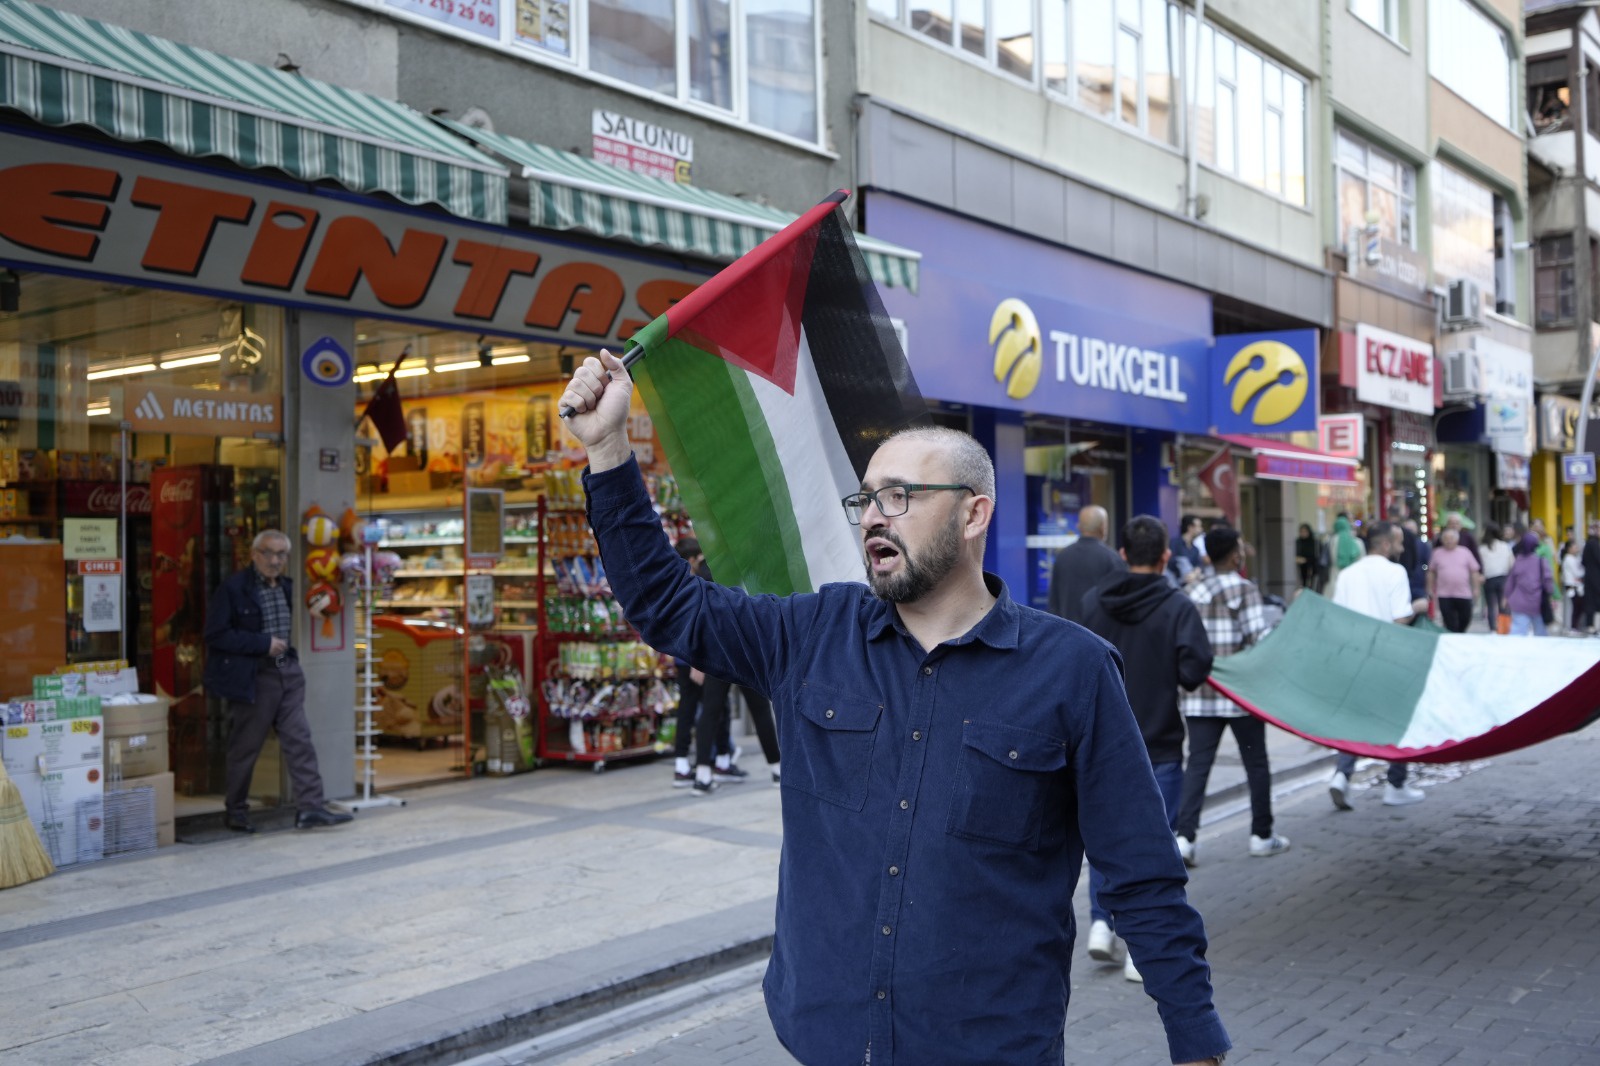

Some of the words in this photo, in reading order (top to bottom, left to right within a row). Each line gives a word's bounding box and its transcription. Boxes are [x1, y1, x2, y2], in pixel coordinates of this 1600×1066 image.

[1049, 329, 1187, 403] TURKCELL
[1366, 337, 1430, 386] ECZANE
[1329, 425, 1349, 451] E
